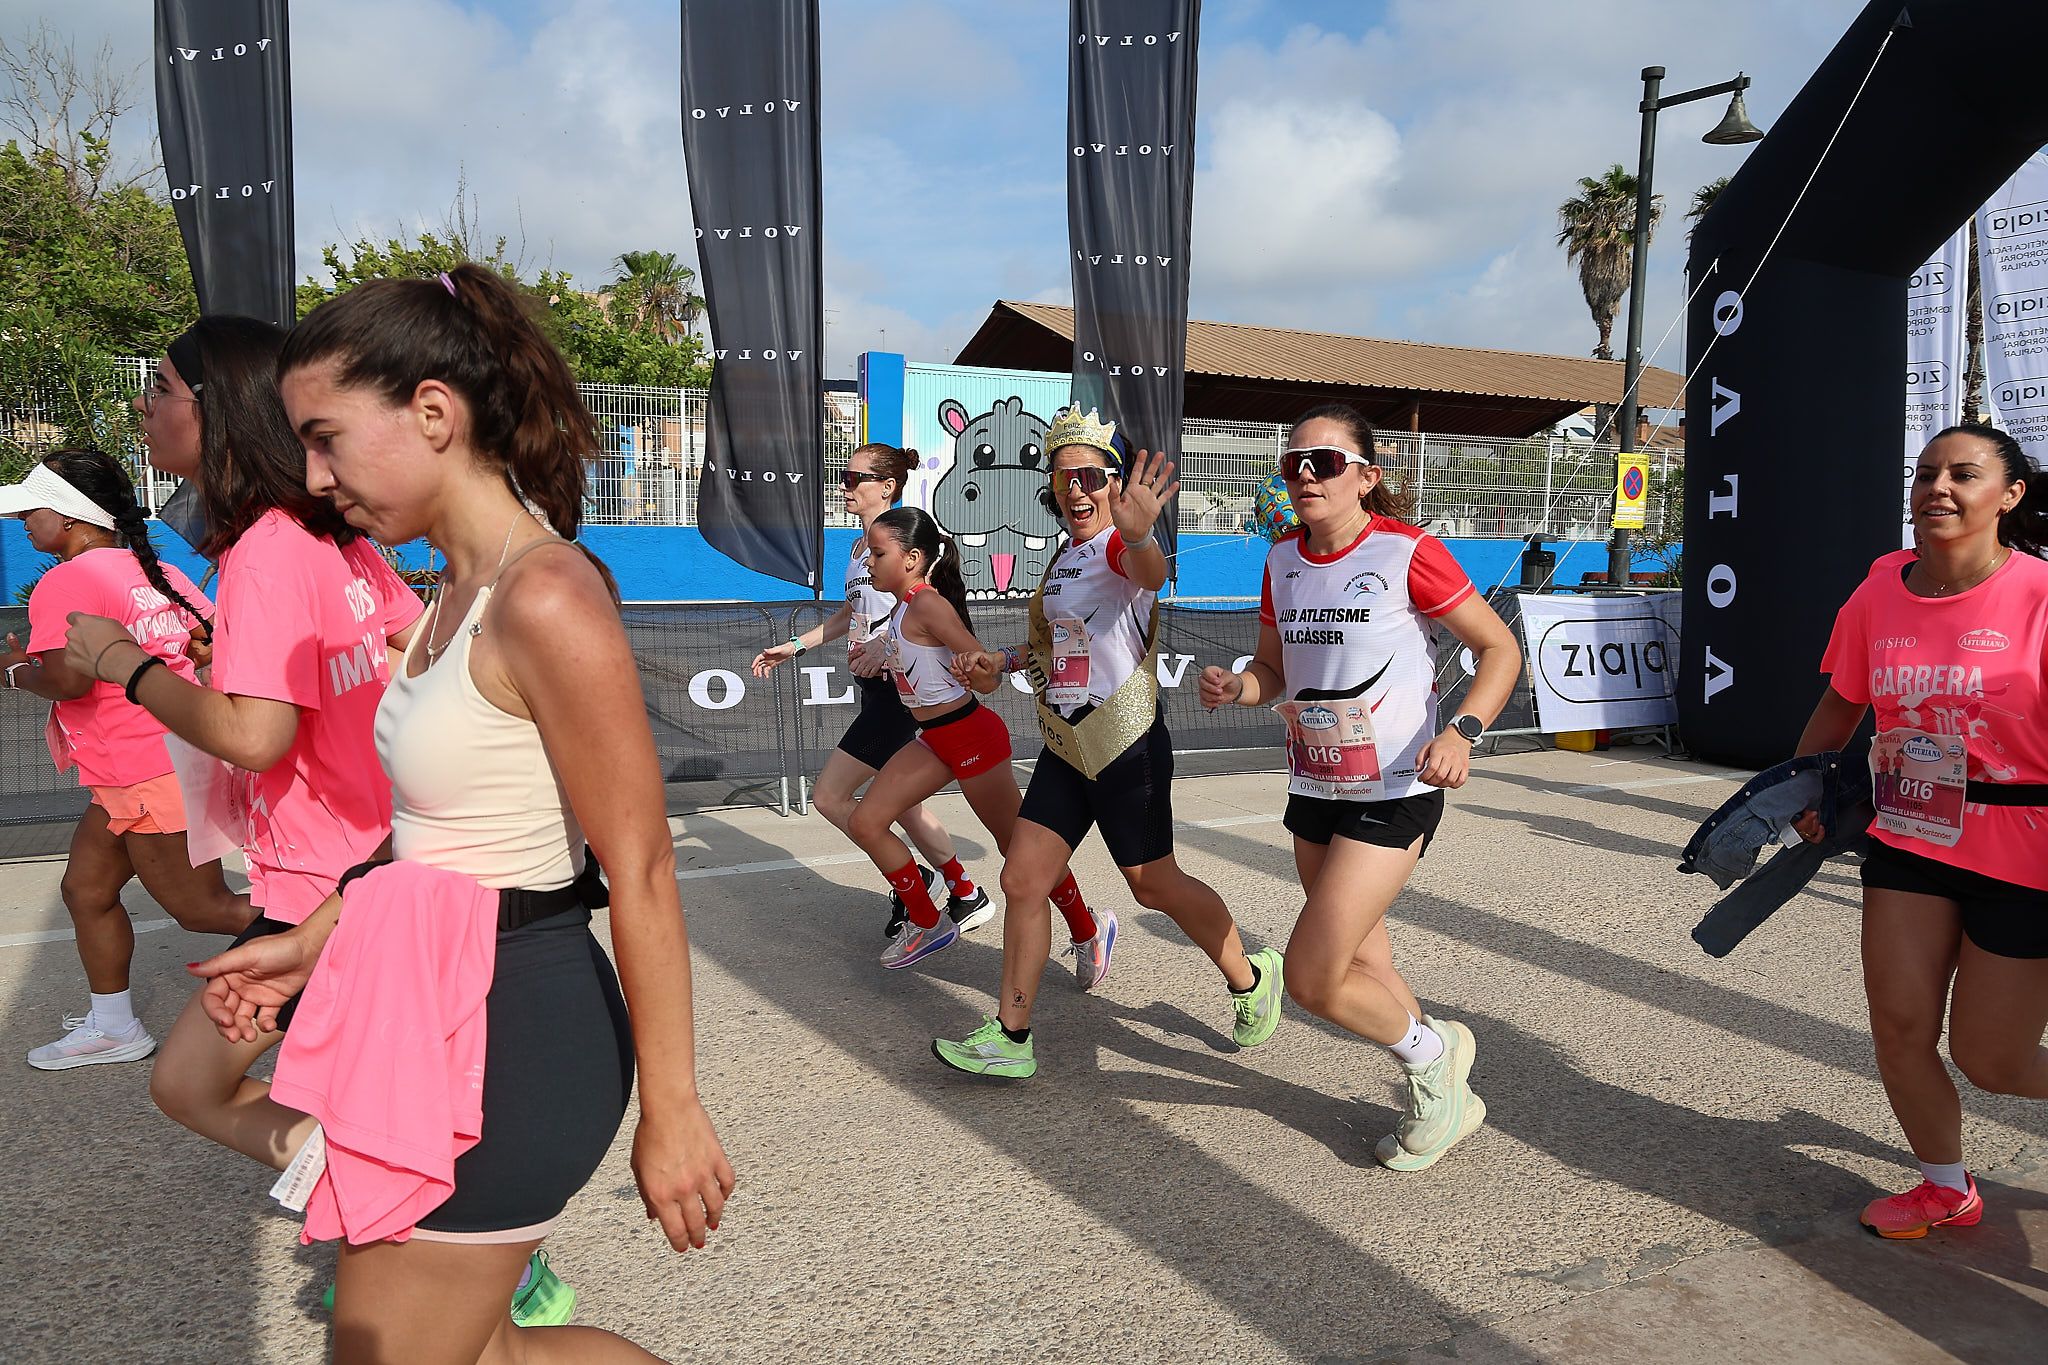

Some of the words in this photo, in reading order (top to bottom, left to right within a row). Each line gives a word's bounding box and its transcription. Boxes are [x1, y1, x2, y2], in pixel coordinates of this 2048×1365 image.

[1704, 291, 1743, 704] VOLVO
[1299, 608, 1370, 622] ATLETISME
[1284, 627, 1344, 645] ALCÀSSER
[1961, 638, 2005, 648] ASTURIANA
[1875, 637, 1917, 650] OYSHO
[1561, 640, 1669, 688] ziaja
[1301, 715, 1336, 724] ASTURIANA
[1308, 746, 1342, 763] 016
[1905, 743, 1941, 757] ASTURIANA
[1340, 787, 1372, 795] Santander
[1900, 778, 1934, 800] 016
